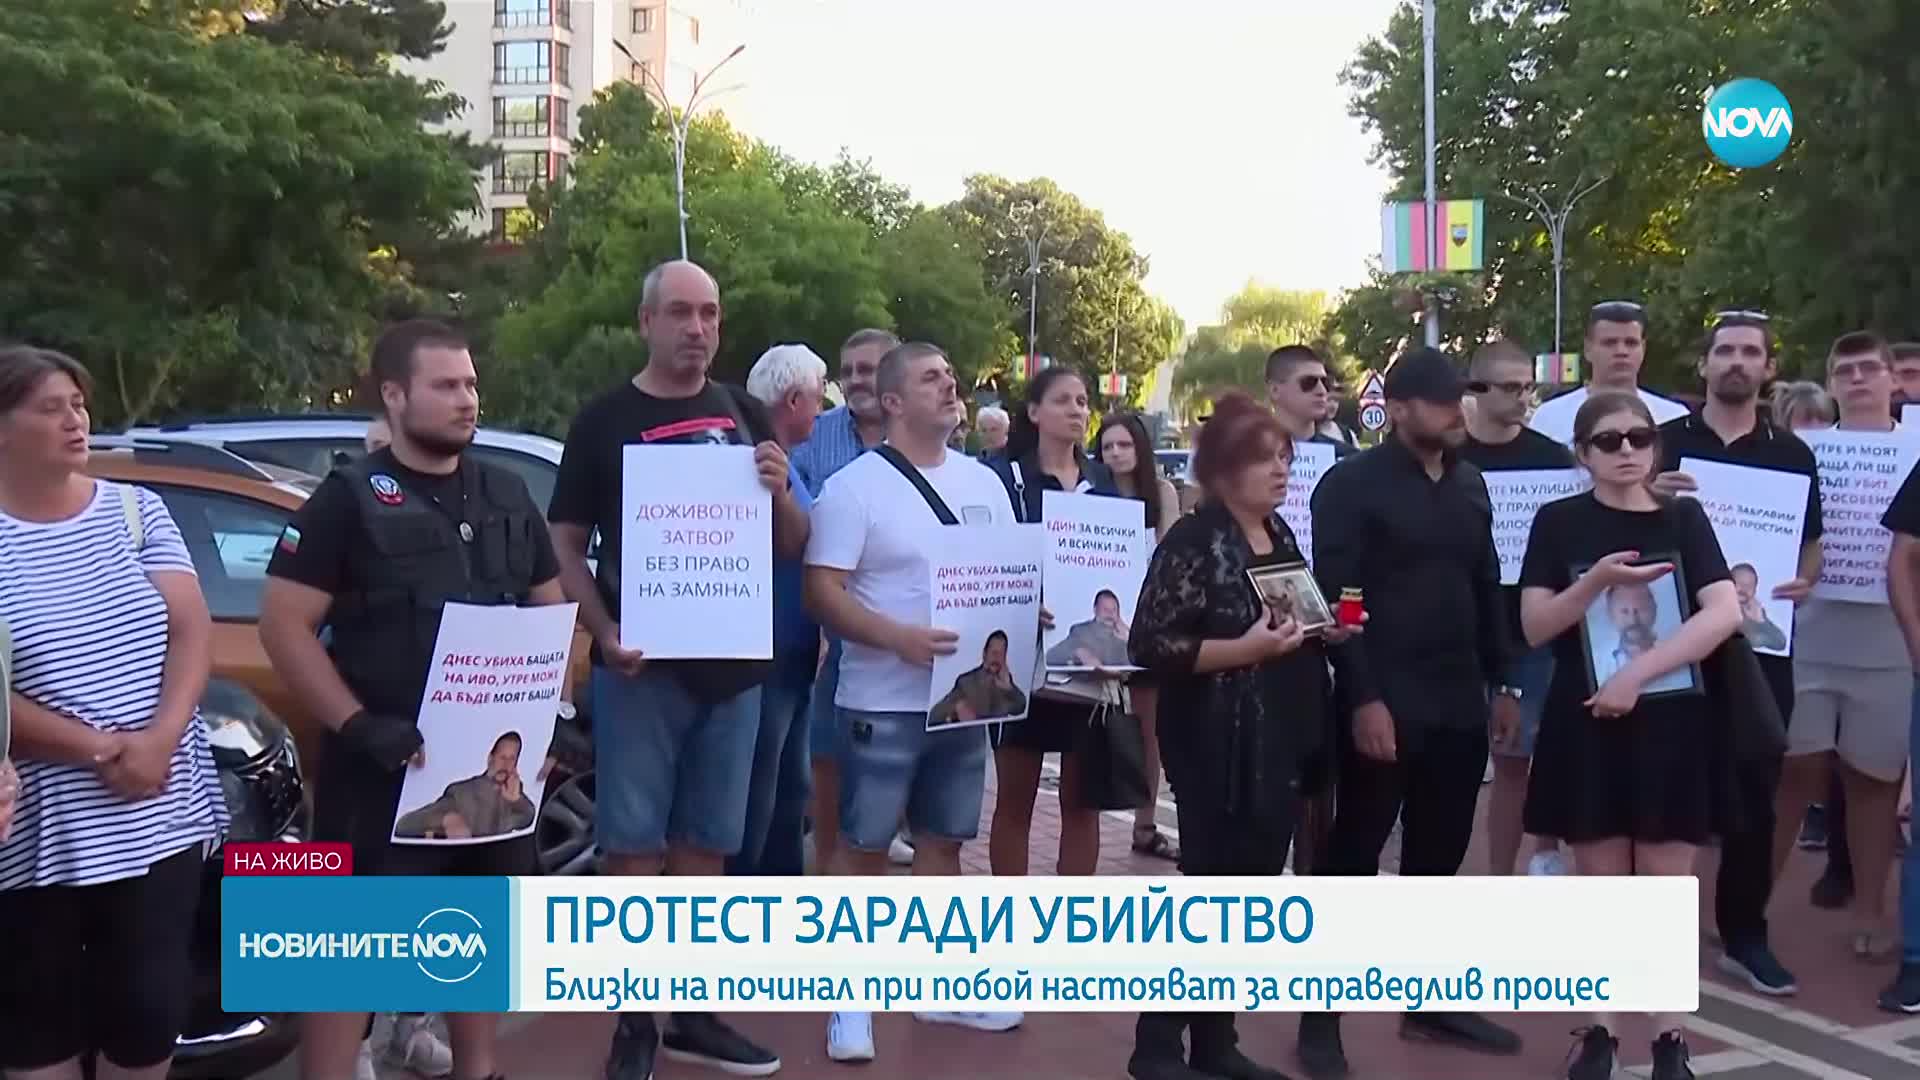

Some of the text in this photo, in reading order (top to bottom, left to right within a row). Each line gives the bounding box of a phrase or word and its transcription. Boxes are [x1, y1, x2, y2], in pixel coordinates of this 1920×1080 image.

[1365, 410, 1382, 425] 30
[1813, 444, 1898, 457] УТРЕ И МОЯТ
[1817, 461, 1896, 474] АЩА ЛИ ЩЕ
[1510, 484, 1528, 495] НА
[1530, 482, 1583, 496] УЛИЦАТ
[636, 503, 758, 523] ДОЖИВОТЕН
[1737, 504, 1796, 521] ЗАБРАВИМ
[1047, 520, 1136, 538] ЕДИН ЗА ВСИЧКИ
[1739, 519, 1794, 535] ПРОСТИМ
[661, 529, 735, 546] ЗАТВОР
[1058, 538, 1128, 554] И ВСИЧКИ ЗА
[1823, 542, 1885, 553] АЧИН ПО
[646, 556, 750, 572] БЕЗ ПРАВО
[1055, 552, 1085, 566] ЧИЧО
[1087, 555, 1126, 569] ДИНКО
[937, 564, 1037, 578] ДНЕС УБИХА БАЩАТА
[942, 583, 956, 593] НА
[984, 580, 1006, 591] УТРЕ
[1007, 580, 1033, 590] МОЖЕ
[1820, 574, 1875, 587] ОДБУДИ
[639, 583, 665, 598] НА
[670, 582, 751, 598] ЗАМЯНА
[936, 599, 951, 610] ДА
[954, 598, 979, 609] БЪДЕ
[981, 596, 1006, 607] МОЯТ
[442, 651, 564, 668] ДНЕС УБИХА БАЩАТА
[444, 669, 559, 687] НА ИВО, УТРЕ МОЖЕ
[430, 690, 452, 703] ДА
[456, 692, 490, 705] БЪДЕ
[493, 691, 526, 703] МОЯТ
